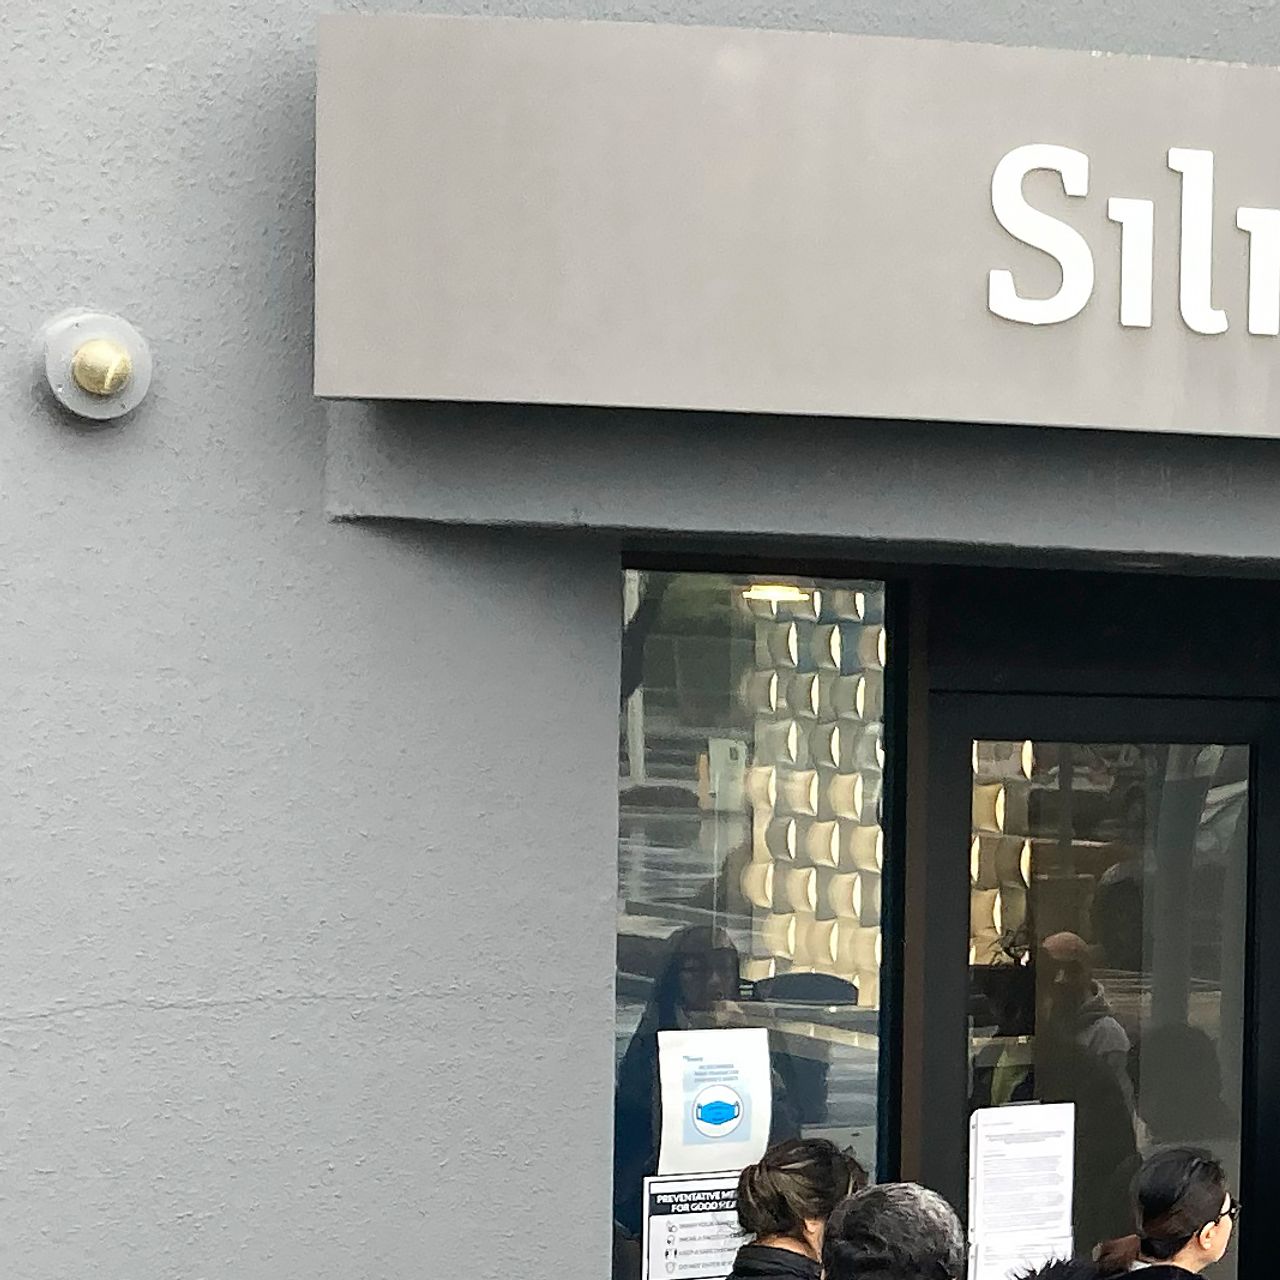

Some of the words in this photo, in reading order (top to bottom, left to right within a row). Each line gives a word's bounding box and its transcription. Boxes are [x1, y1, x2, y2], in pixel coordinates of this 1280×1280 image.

[656, 1190, 720, 1204] PREVENTATIVE
[671, 1203, 690, 1213] FOR
[690, 1201, 717, 1212] GOOD
